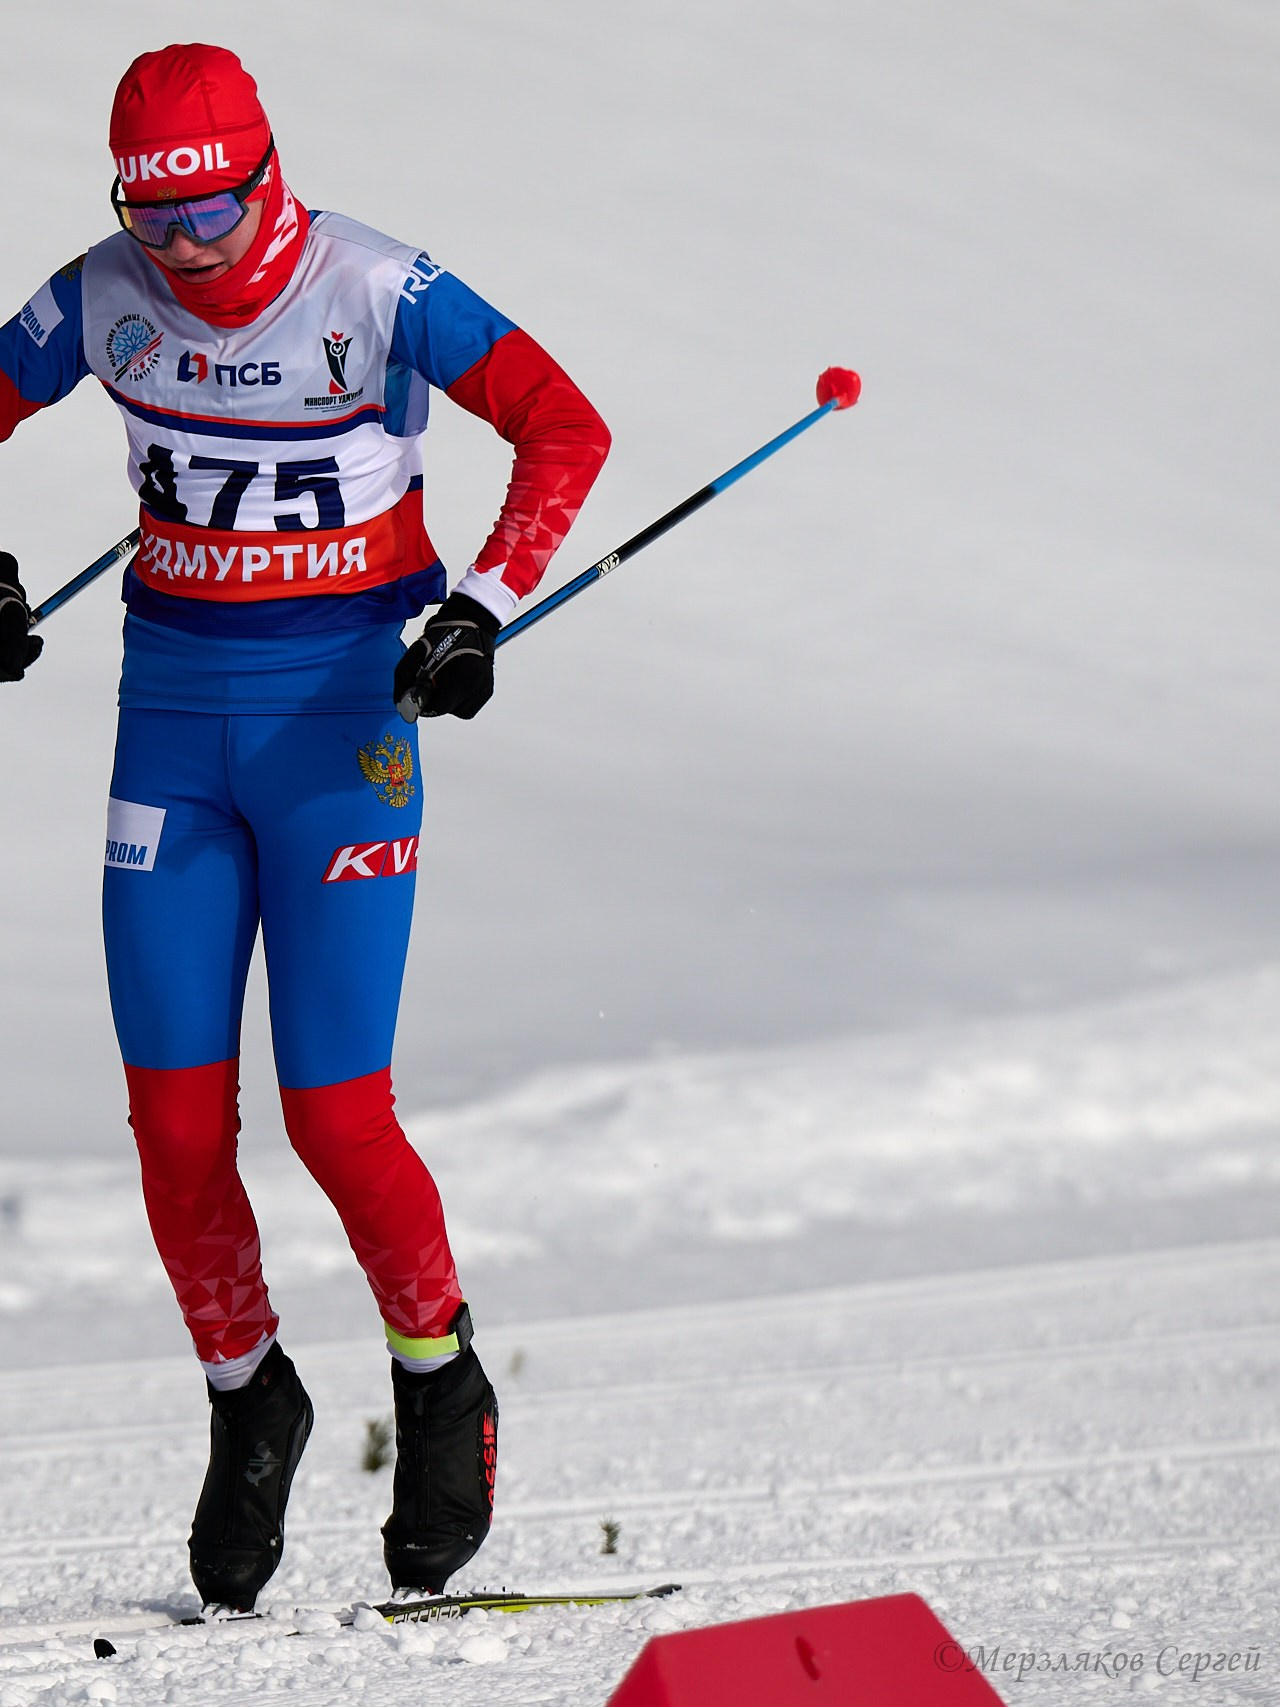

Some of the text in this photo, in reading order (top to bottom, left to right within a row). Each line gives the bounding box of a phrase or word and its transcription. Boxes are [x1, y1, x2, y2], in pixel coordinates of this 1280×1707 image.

[115, 143, 230, 183] UKOIL
[215, 362, 282, 387] ПСБ
[304, 396, 337, 407] МИНСПОРТ
[139, 443, 345, 531] 475
